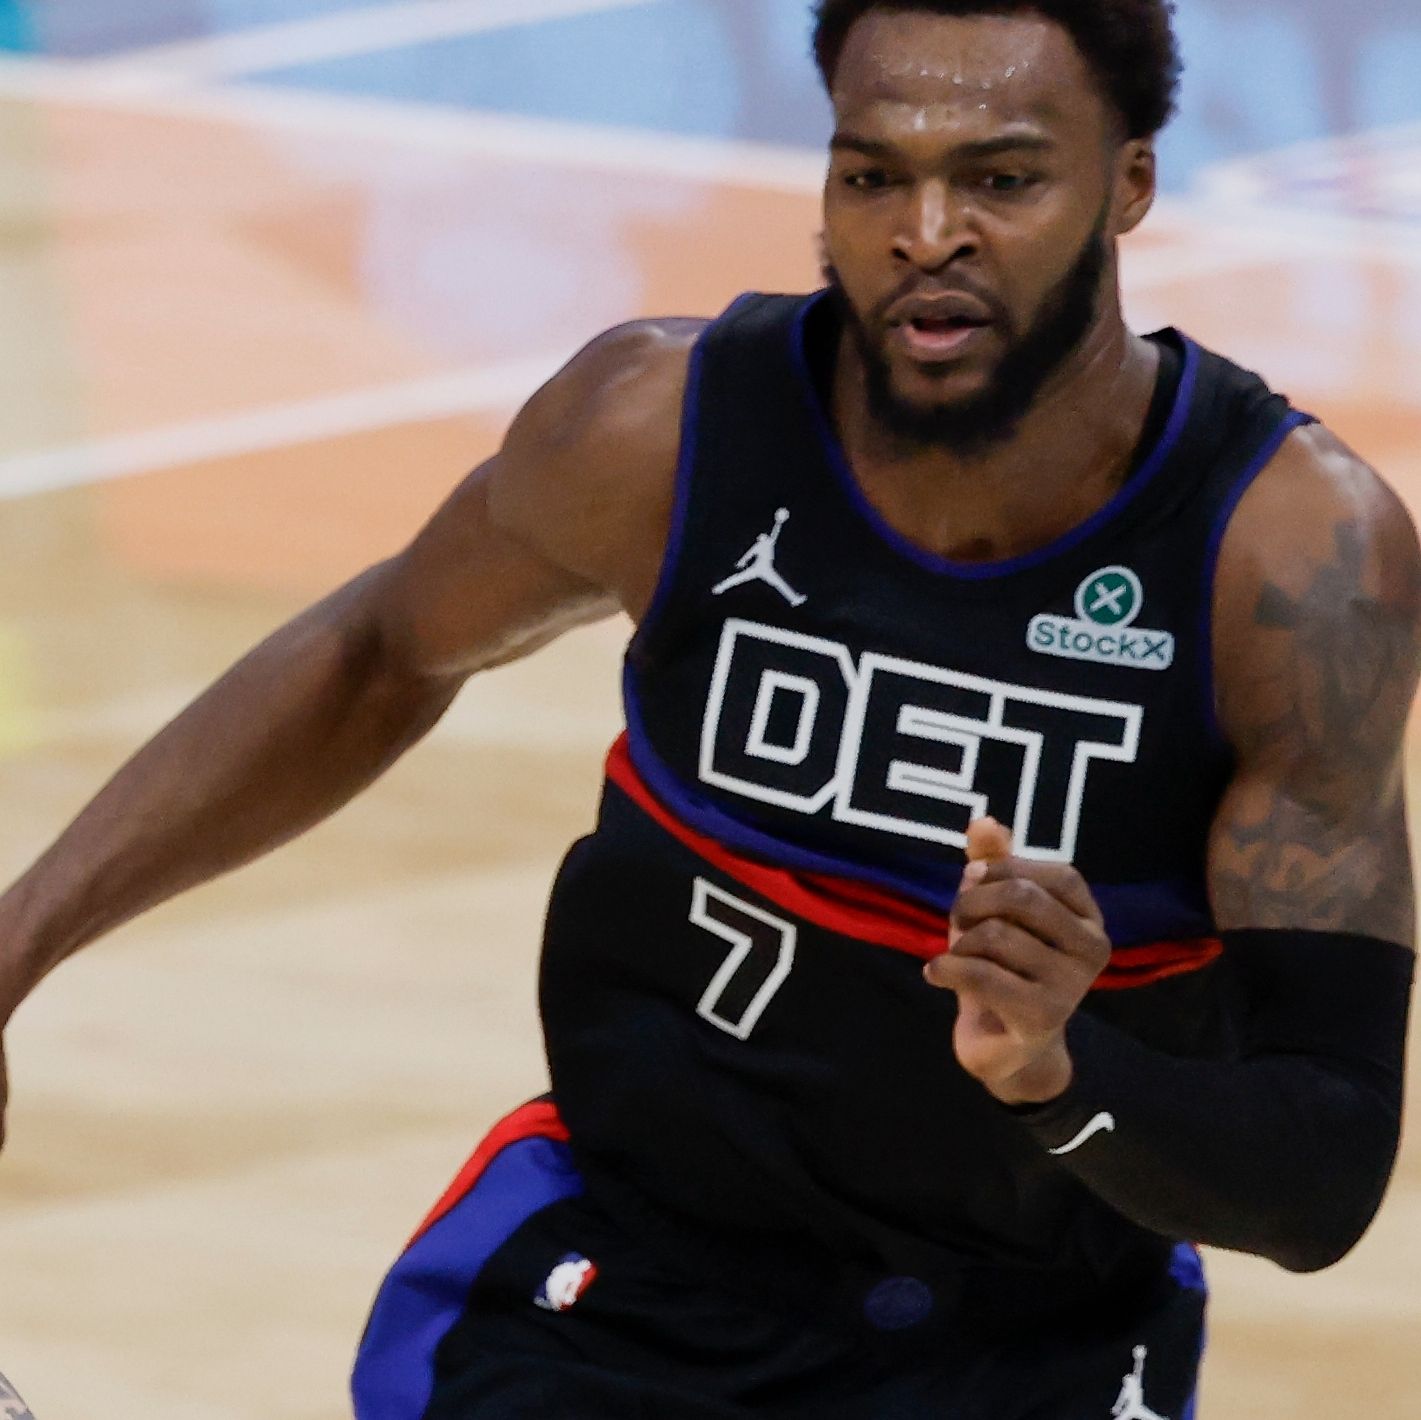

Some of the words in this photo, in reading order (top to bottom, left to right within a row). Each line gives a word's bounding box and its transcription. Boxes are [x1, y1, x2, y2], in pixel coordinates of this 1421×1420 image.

[1034, 621, 1168, 661] StockX
[698, 617, 1143, 864] DET
[689, 876, 797, 1041] 7
